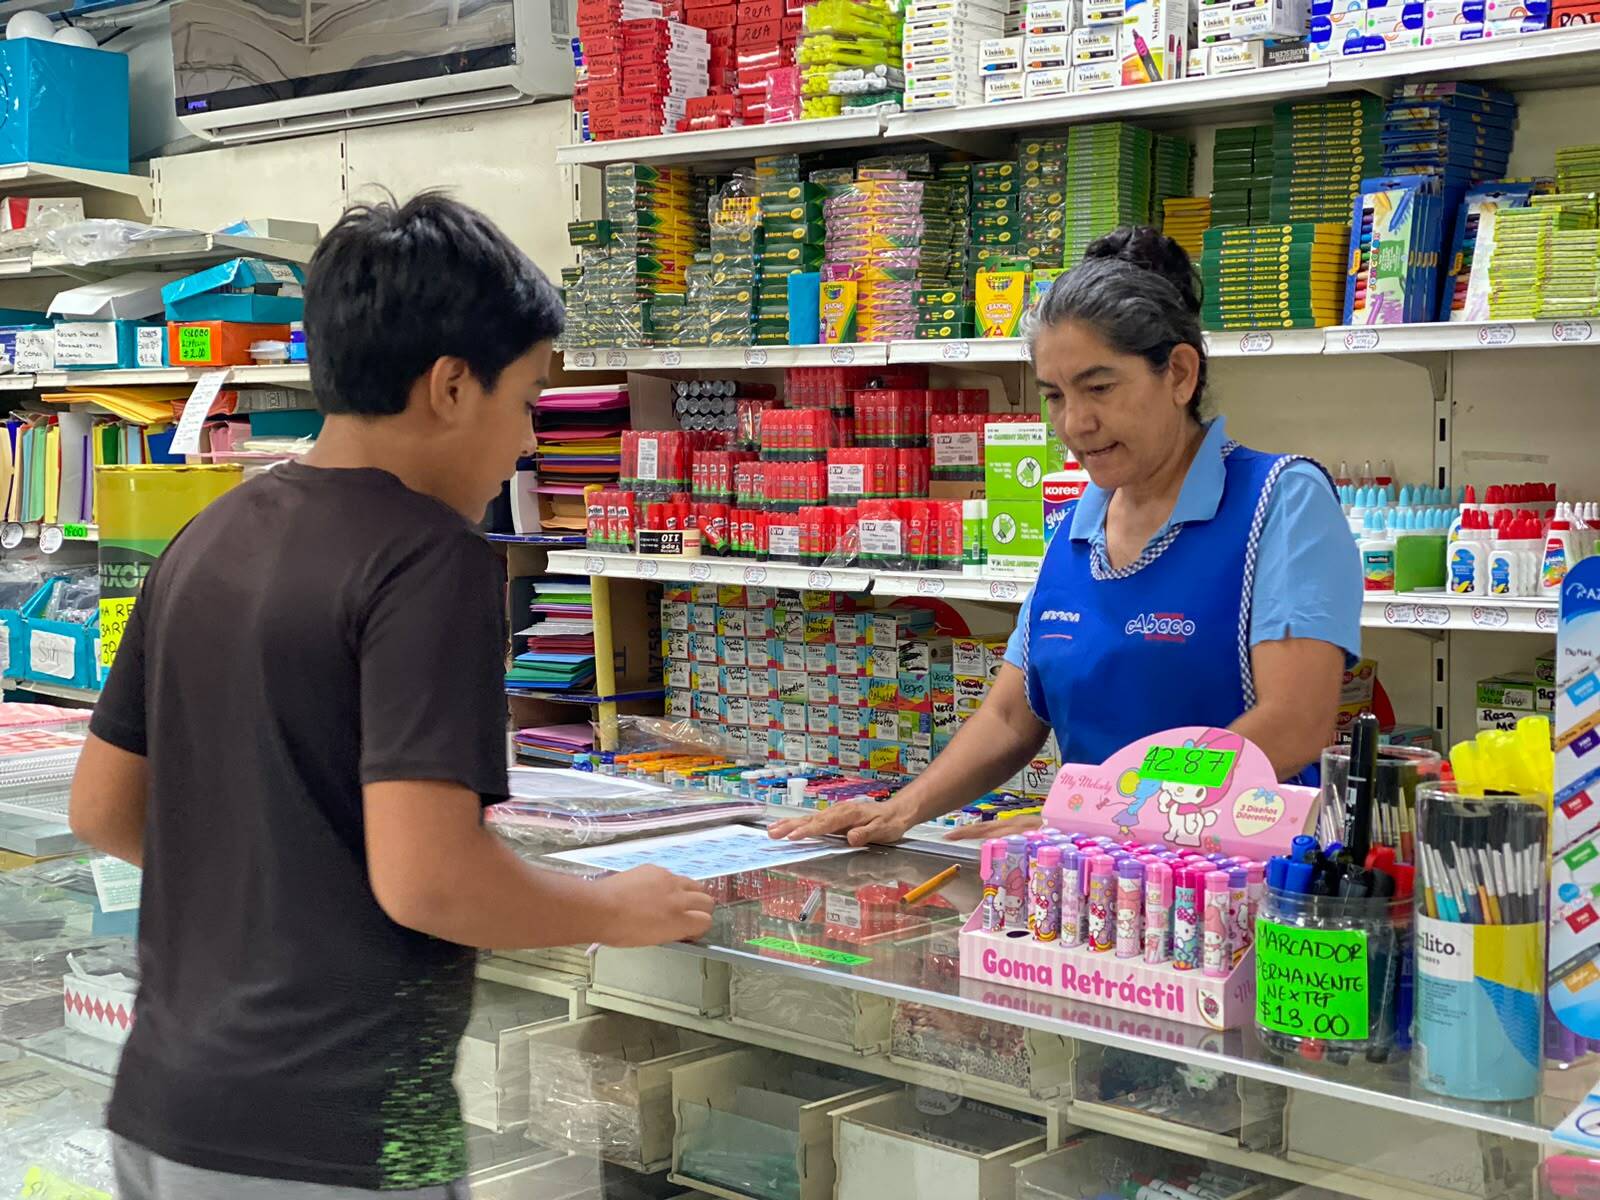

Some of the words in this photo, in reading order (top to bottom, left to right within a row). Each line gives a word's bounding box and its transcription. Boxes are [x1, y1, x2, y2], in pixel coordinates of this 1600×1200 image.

[1125, 613, 1195, 635] Abaco
[1144, 746, 1226, 773] 42.87
[1059, 771, 1077, 789] My
[1078, 775, 1114, 794] Melody
[1235, 811, 1277, 824] Diferentes
[1247, 804, 1278, 816] Diseños
[1258, 925, 1362, 964] MARCADOR
[982, 948, 1053, 986] Goma
[1061, 963, 1184, 1013] Retráctil
[1261, 999, 1350, 1037] $13.00
